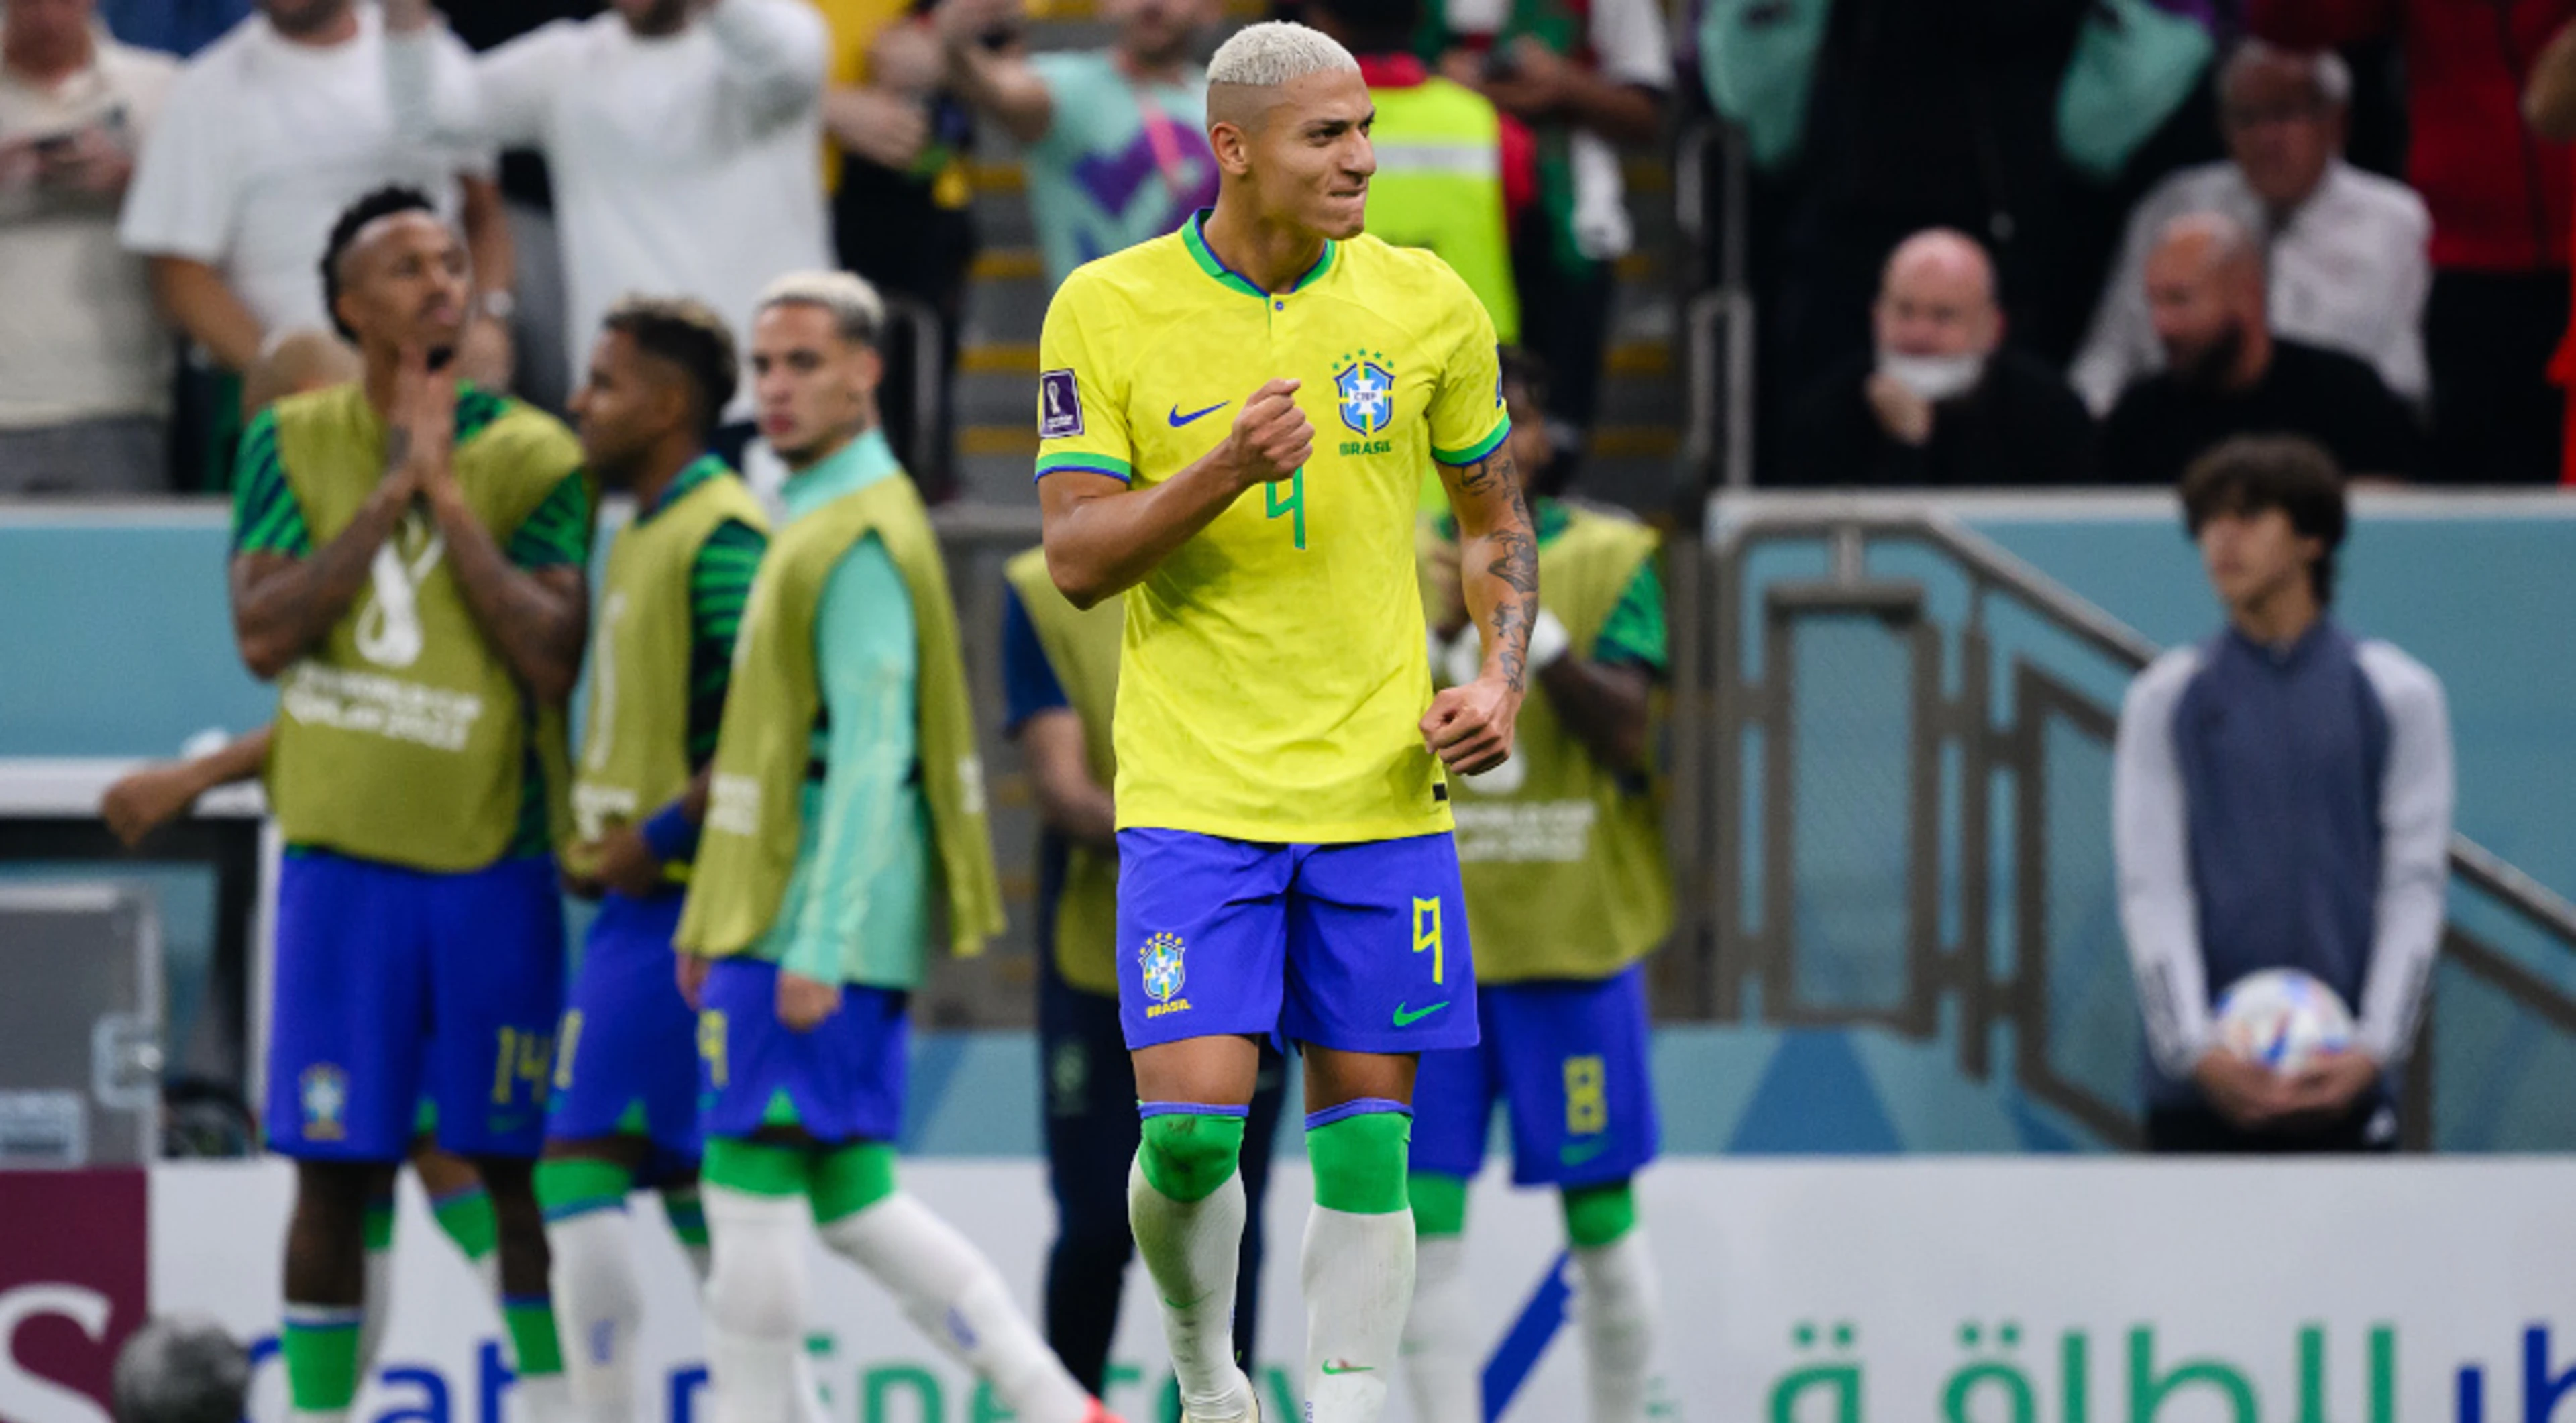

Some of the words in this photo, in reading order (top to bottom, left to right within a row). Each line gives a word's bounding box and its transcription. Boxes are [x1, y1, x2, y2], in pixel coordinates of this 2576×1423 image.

[1340, 439, 1391, 456] BRASIL
[1412, 896, 1442, 984] 9
[1146, 998, 1192, 1018] BRASIL
[492, 1026, 553, 1104] 14
[1563, 1055, 1607, 1135] 8
